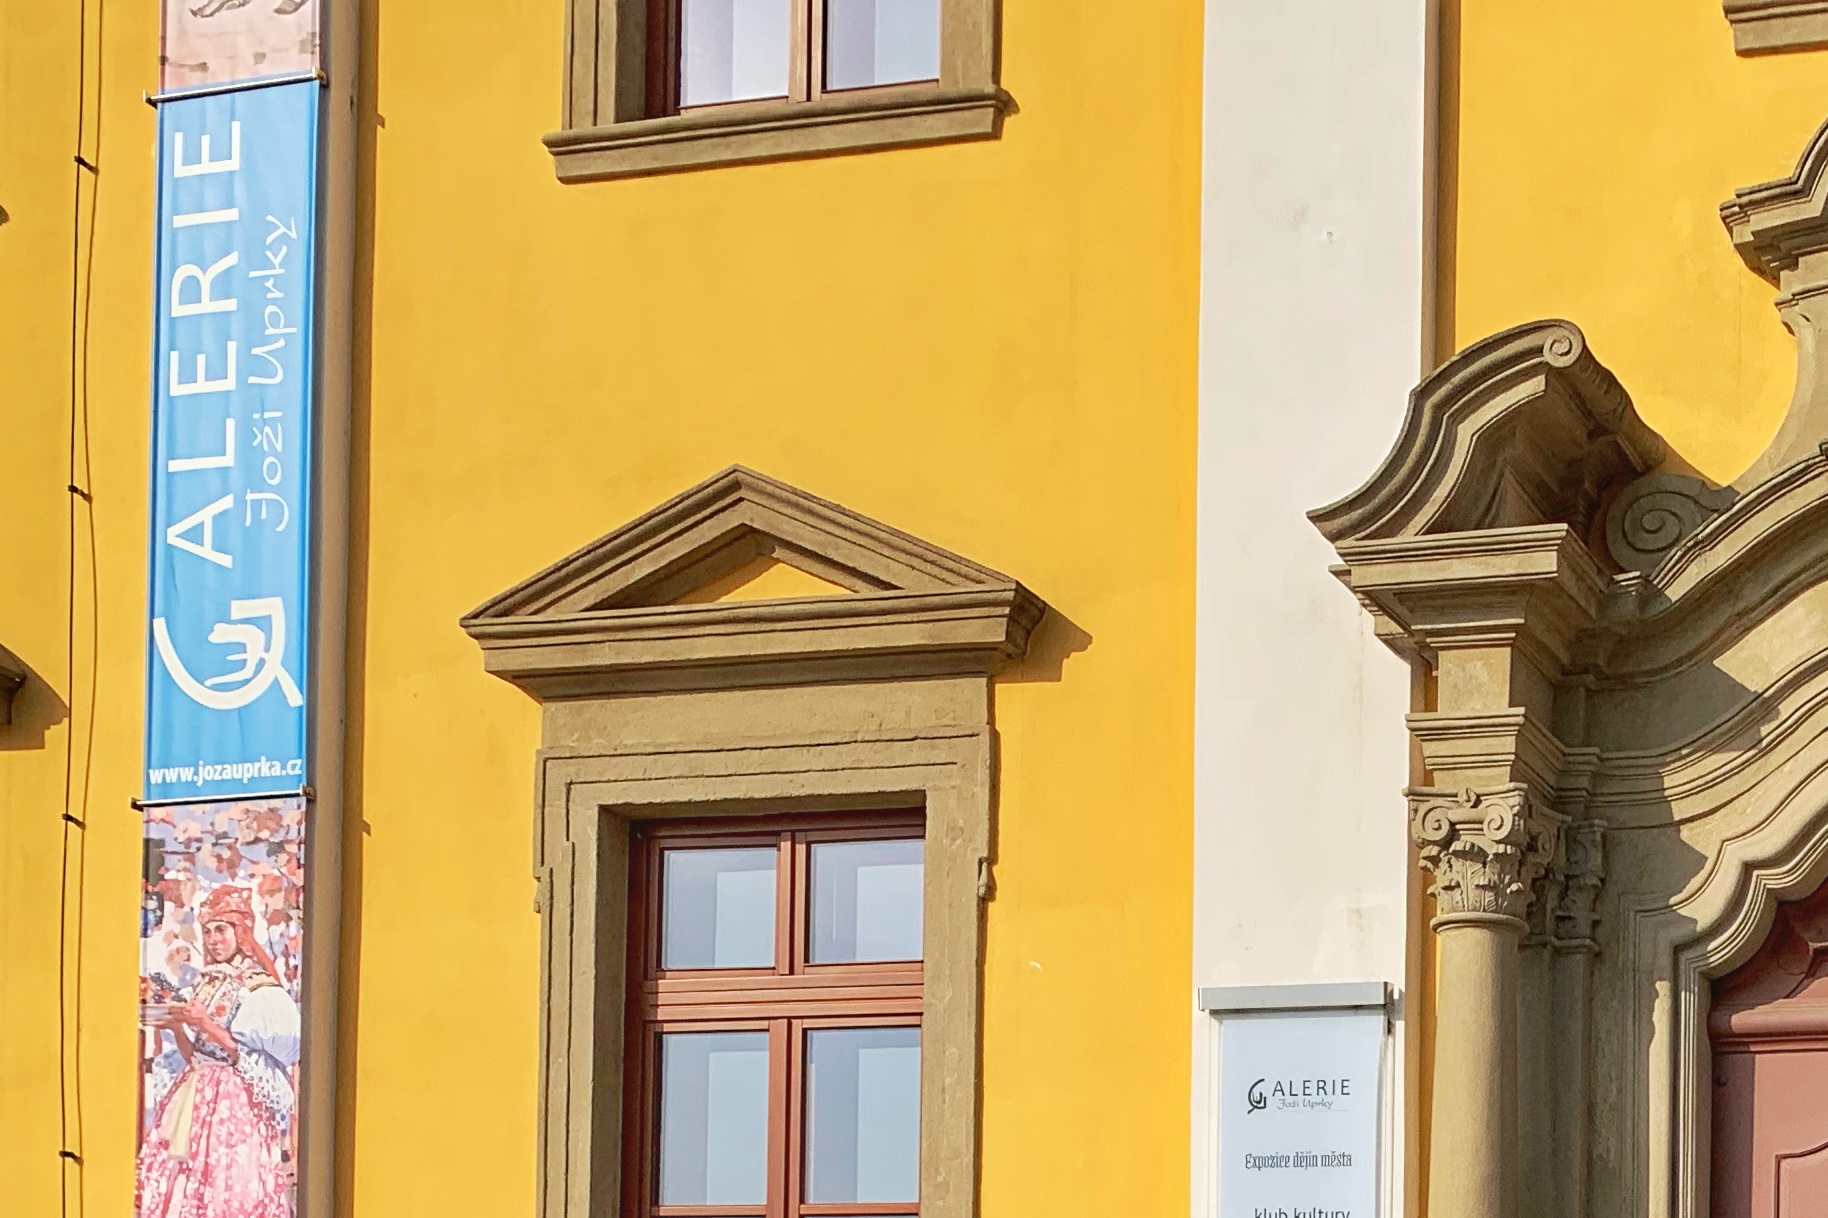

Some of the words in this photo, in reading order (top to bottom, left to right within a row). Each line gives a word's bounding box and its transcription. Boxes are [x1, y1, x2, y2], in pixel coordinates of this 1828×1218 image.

[149, 756, 303, 787] www.jozauprka.cz
[1245, 1152, 1290, 1171] Expozice
[1293, 1150, 1318, 1170] dějin
[1320, 1150, 1352, 1168] města
